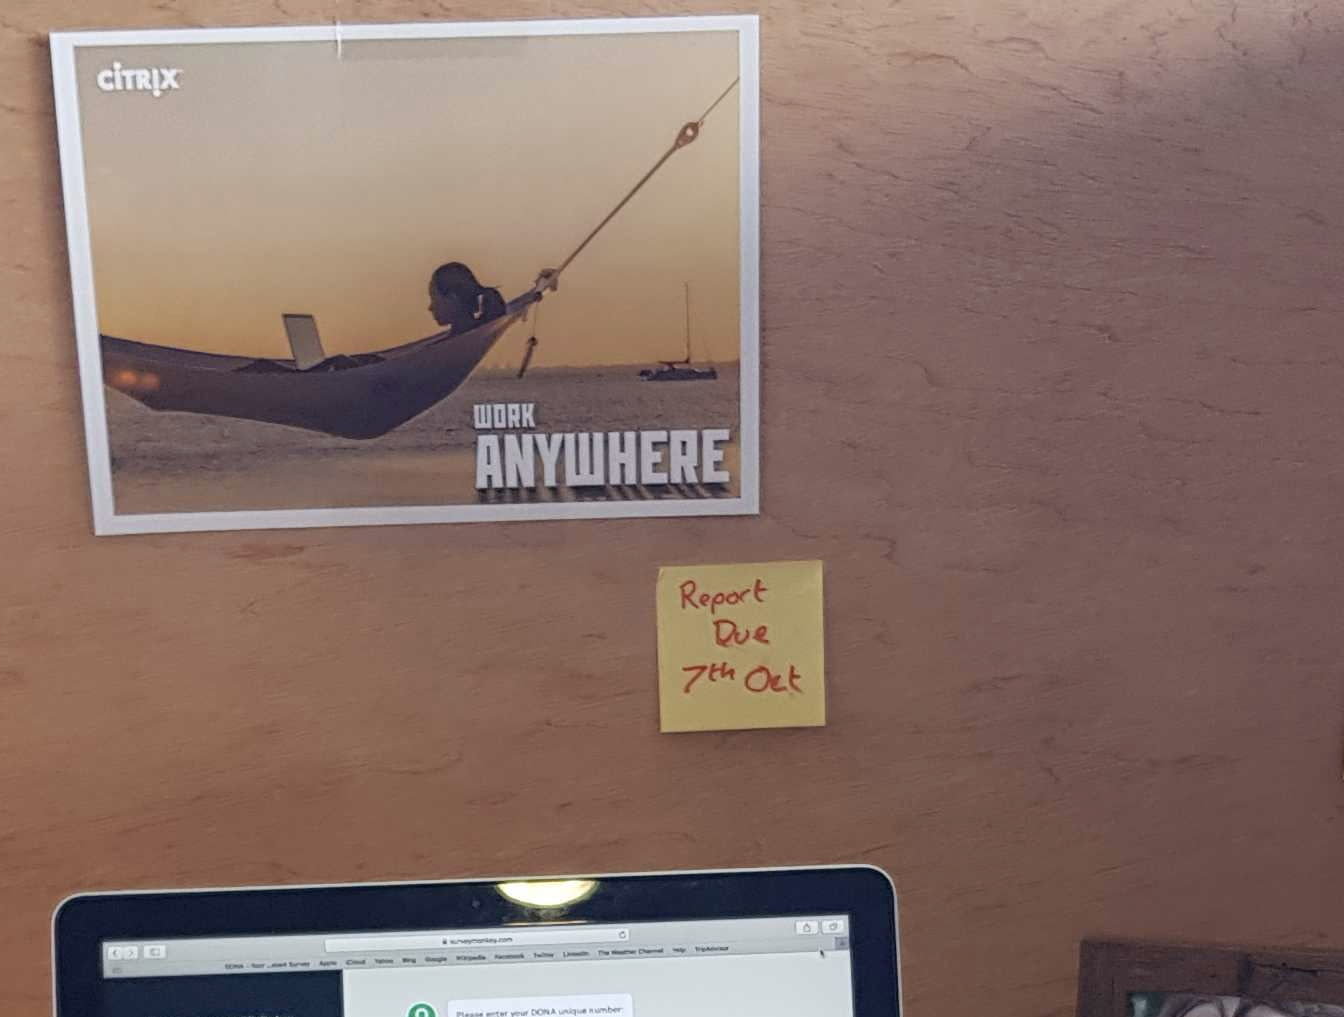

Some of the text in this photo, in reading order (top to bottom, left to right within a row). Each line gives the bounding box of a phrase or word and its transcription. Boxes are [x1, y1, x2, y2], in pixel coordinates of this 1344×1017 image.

[473, 403, 536, 429] WORK
[475, 429, 730, 489] ANYWHERE
[679, 578, 769, 615] Report
[713, 618, 770, 648] Due
[682, 662, 803, 694] 7th Oct
